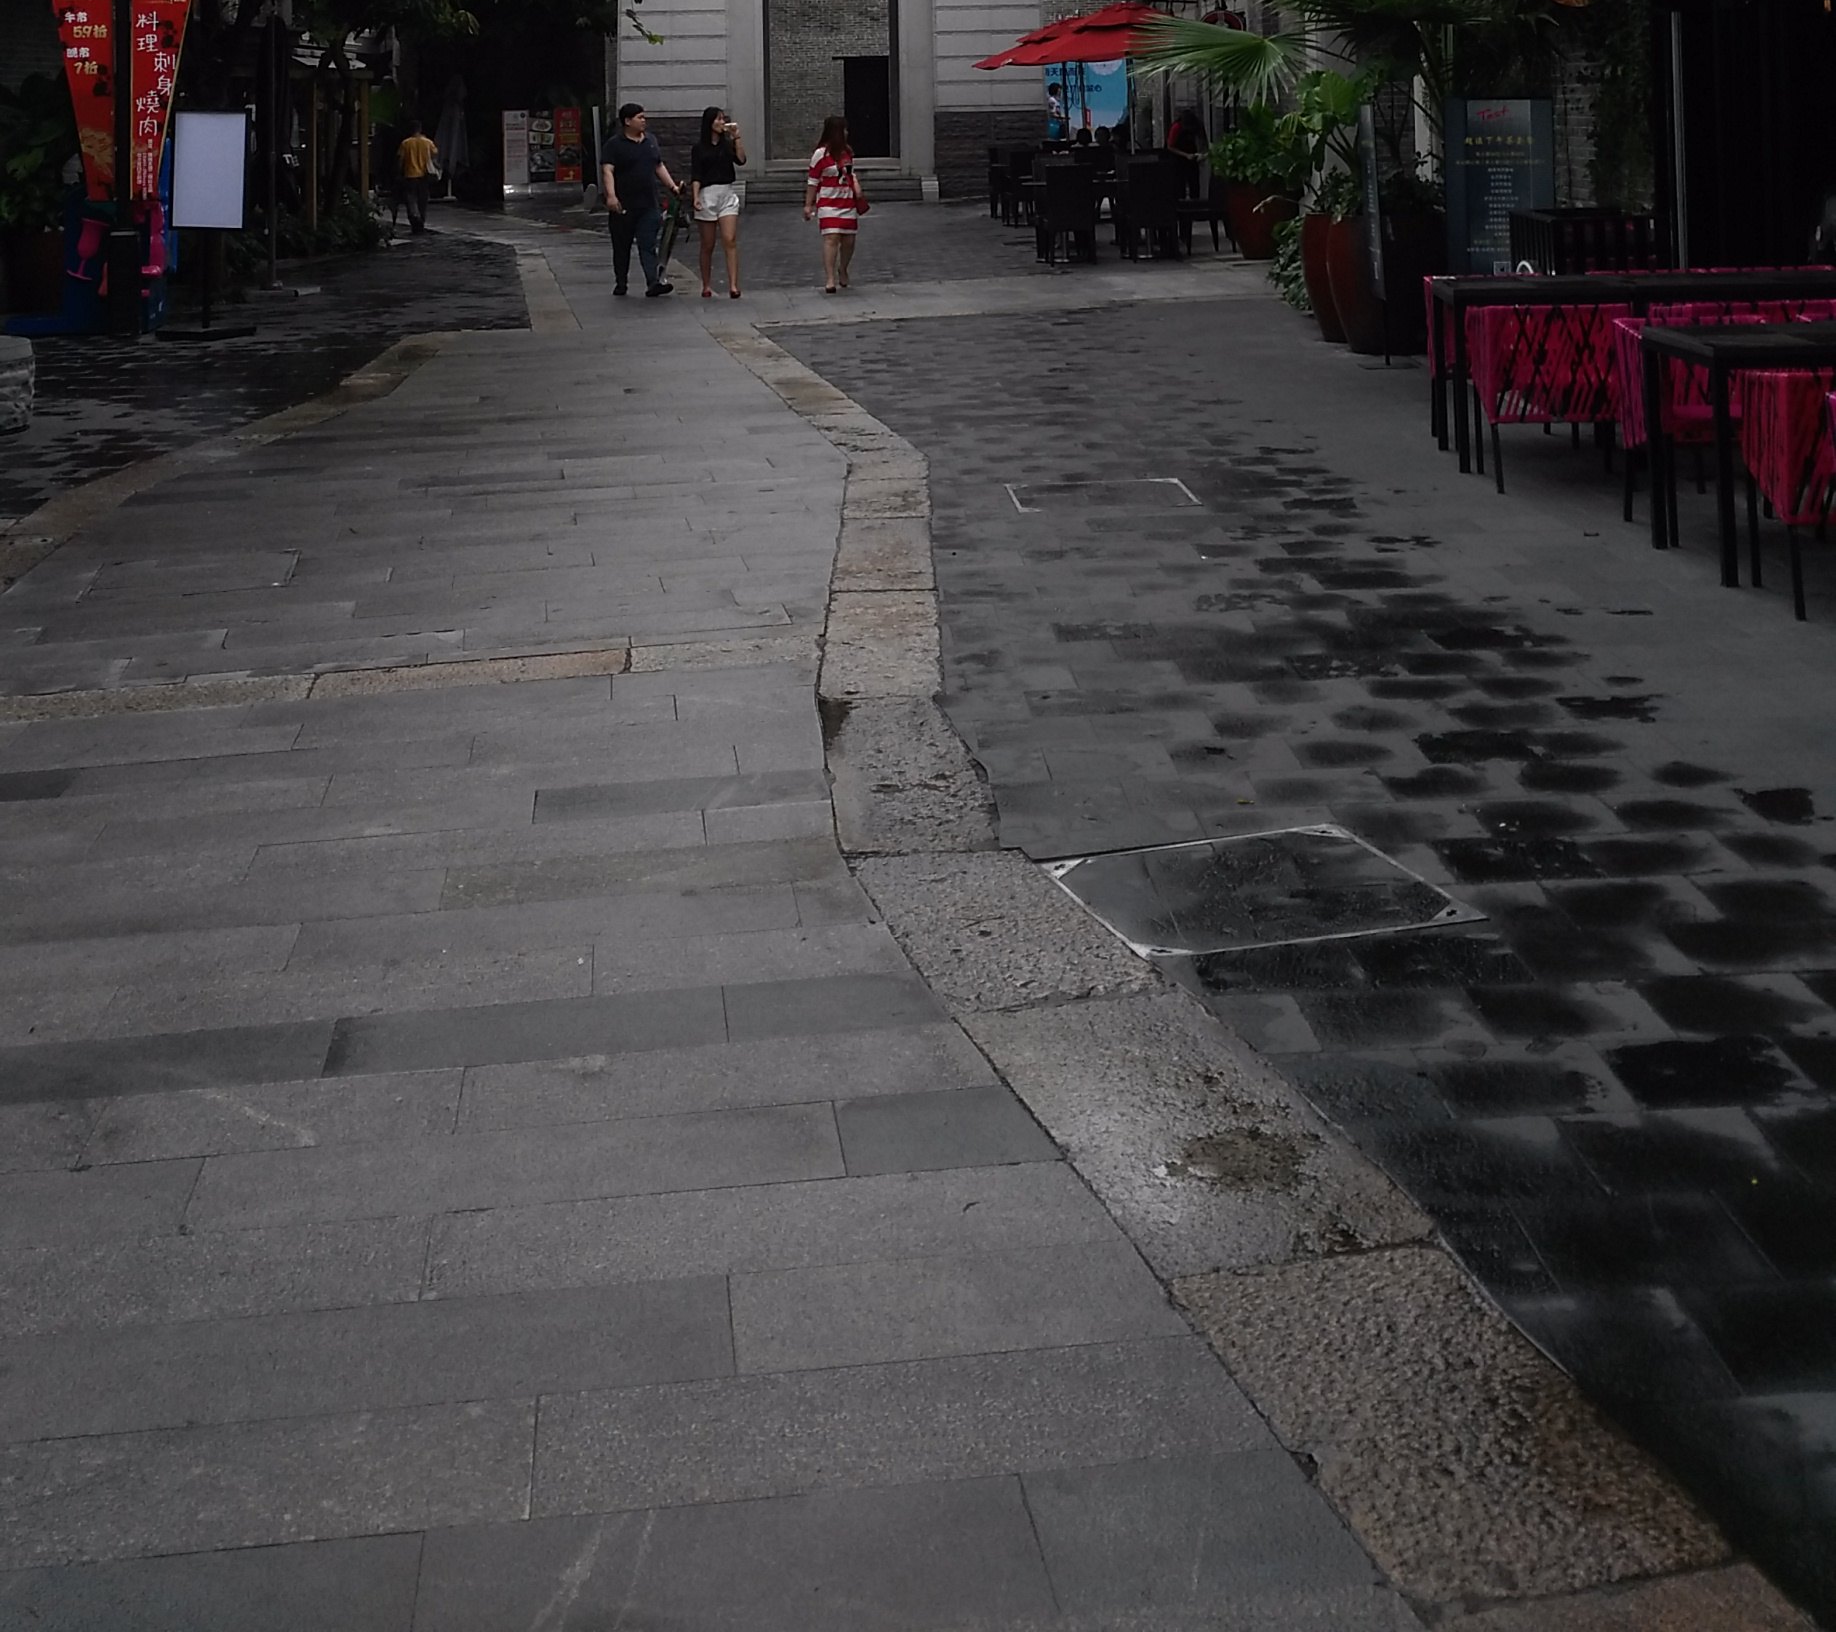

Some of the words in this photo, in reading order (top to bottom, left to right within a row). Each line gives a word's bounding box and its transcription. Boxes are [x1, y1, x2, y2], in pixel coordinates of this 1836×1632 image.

[135, 10, 159, 53] 料理
[154, 51, 176, 97] 刺身
[135, 89, 160, 137] 燒肉
